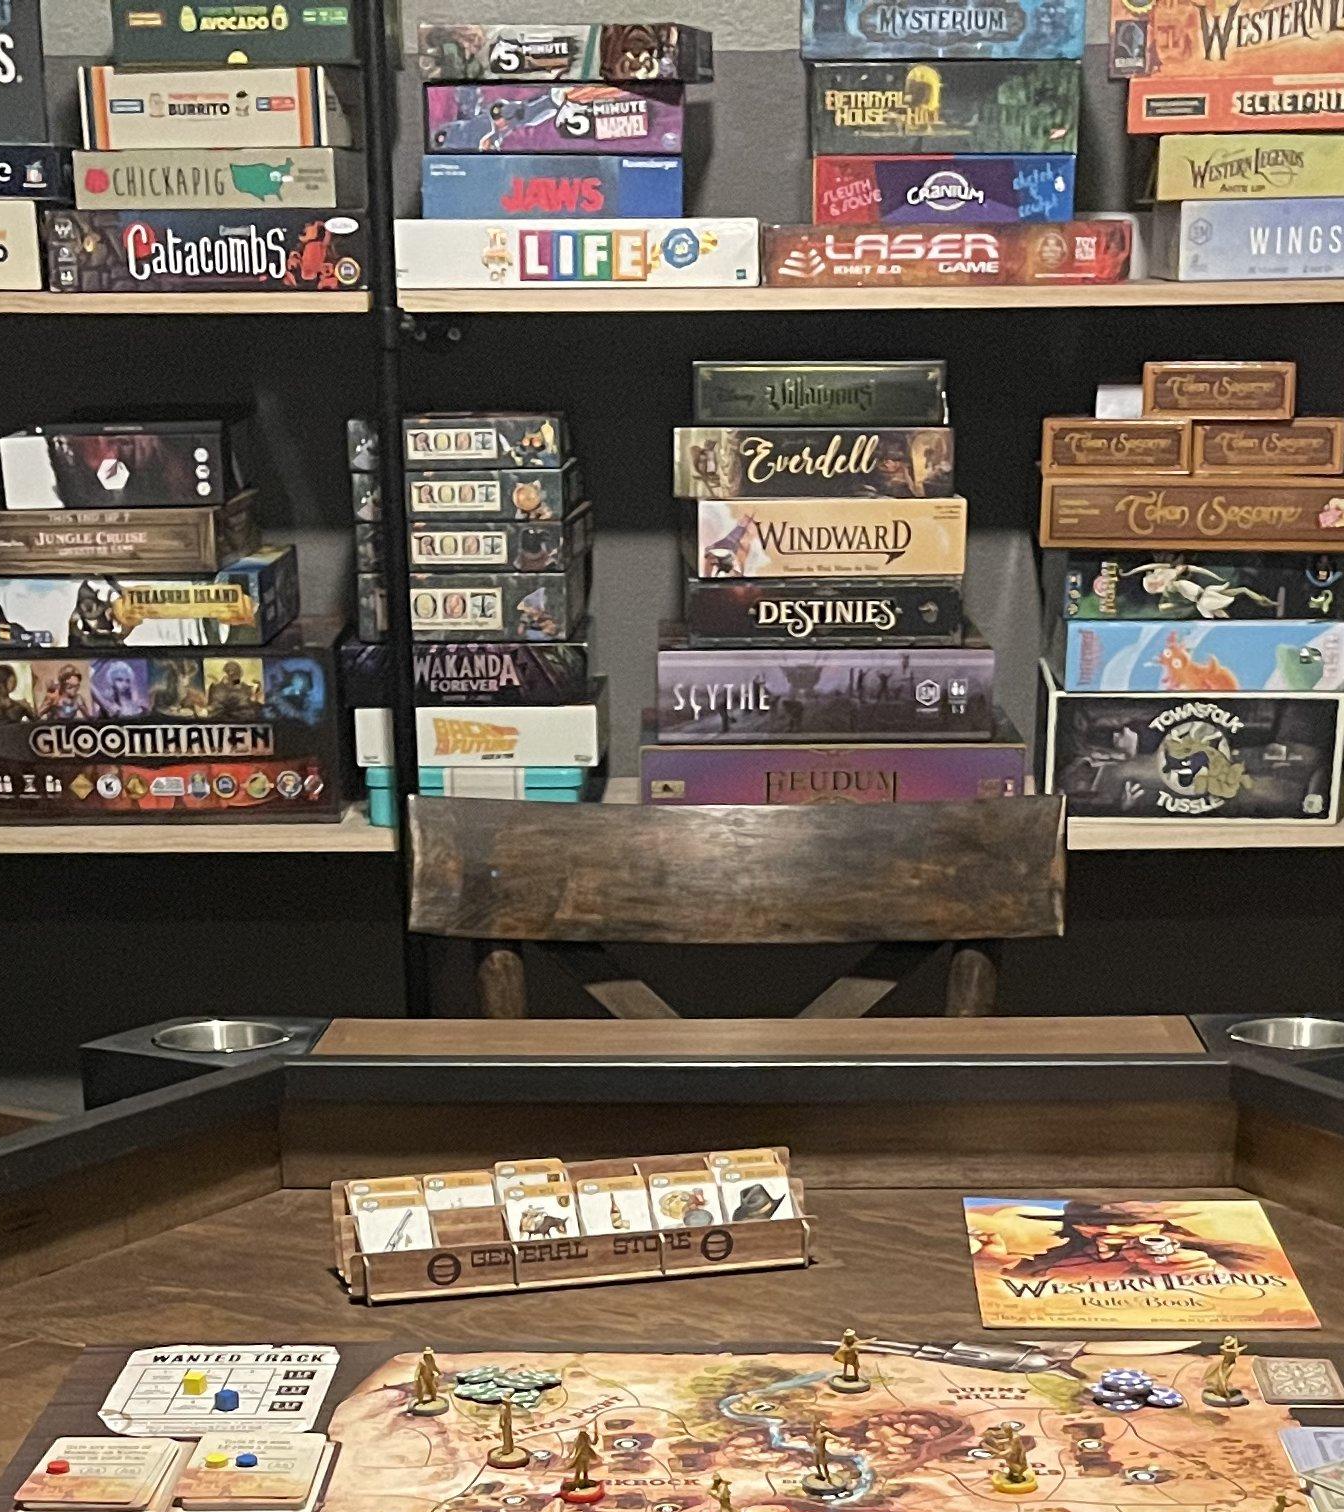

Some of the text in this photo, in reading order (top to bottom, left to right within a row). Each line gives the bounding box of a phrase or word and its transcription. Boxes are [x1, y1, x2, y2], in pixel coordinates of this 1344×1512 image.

[199, 16, 270, 31] AVOCADO
[879, 8, 1005, 34] MYSTERIUM
[168, 103, 231, 117] BURRITO
[595, 115, 648, 139] MARVEL
[112, 166, 225, 197] CHICKAPIG
[499, 177, 605, 213] JAWS
[522, 232, 646, 279] LIFE
[825, 233, 1000, 260] LASER
[938, 261, 1000, 274] GAME
[409, 431, 493, 452] ROOT
[740, 434, 879, 484] Everdell
[413, 483, 496, 504] ROOT
[34, 531, 147, 547] JUNGLE CRUISE
[413, 534, 503, 556] ROOT
[754, 518, 912, 551] WINDWARD
[129, 588, 240, 605] TREASURE ISLAND
[413, 592, 497, 619] OOT
[758, 599, 897, 637] DESTINIES
[413, 654, 522, 688] WAKANDA
[430, 679, 499, 693] FOREVER
[673, 682, 771, 720] SCYTHE
[1148, 701, 1246, 734] TOWNSFOLK
[29, 724, 274, 758] GLOOMHAVEN
[1156, 790, 1225, 814] TUSSLE
[470, 1231, 692, 1269] GENERAL STORE
[1002, 1271, 1290, 1299] WESTERN LEGENDS
[153, 1354, 325, 1363] WANTED TRACK
